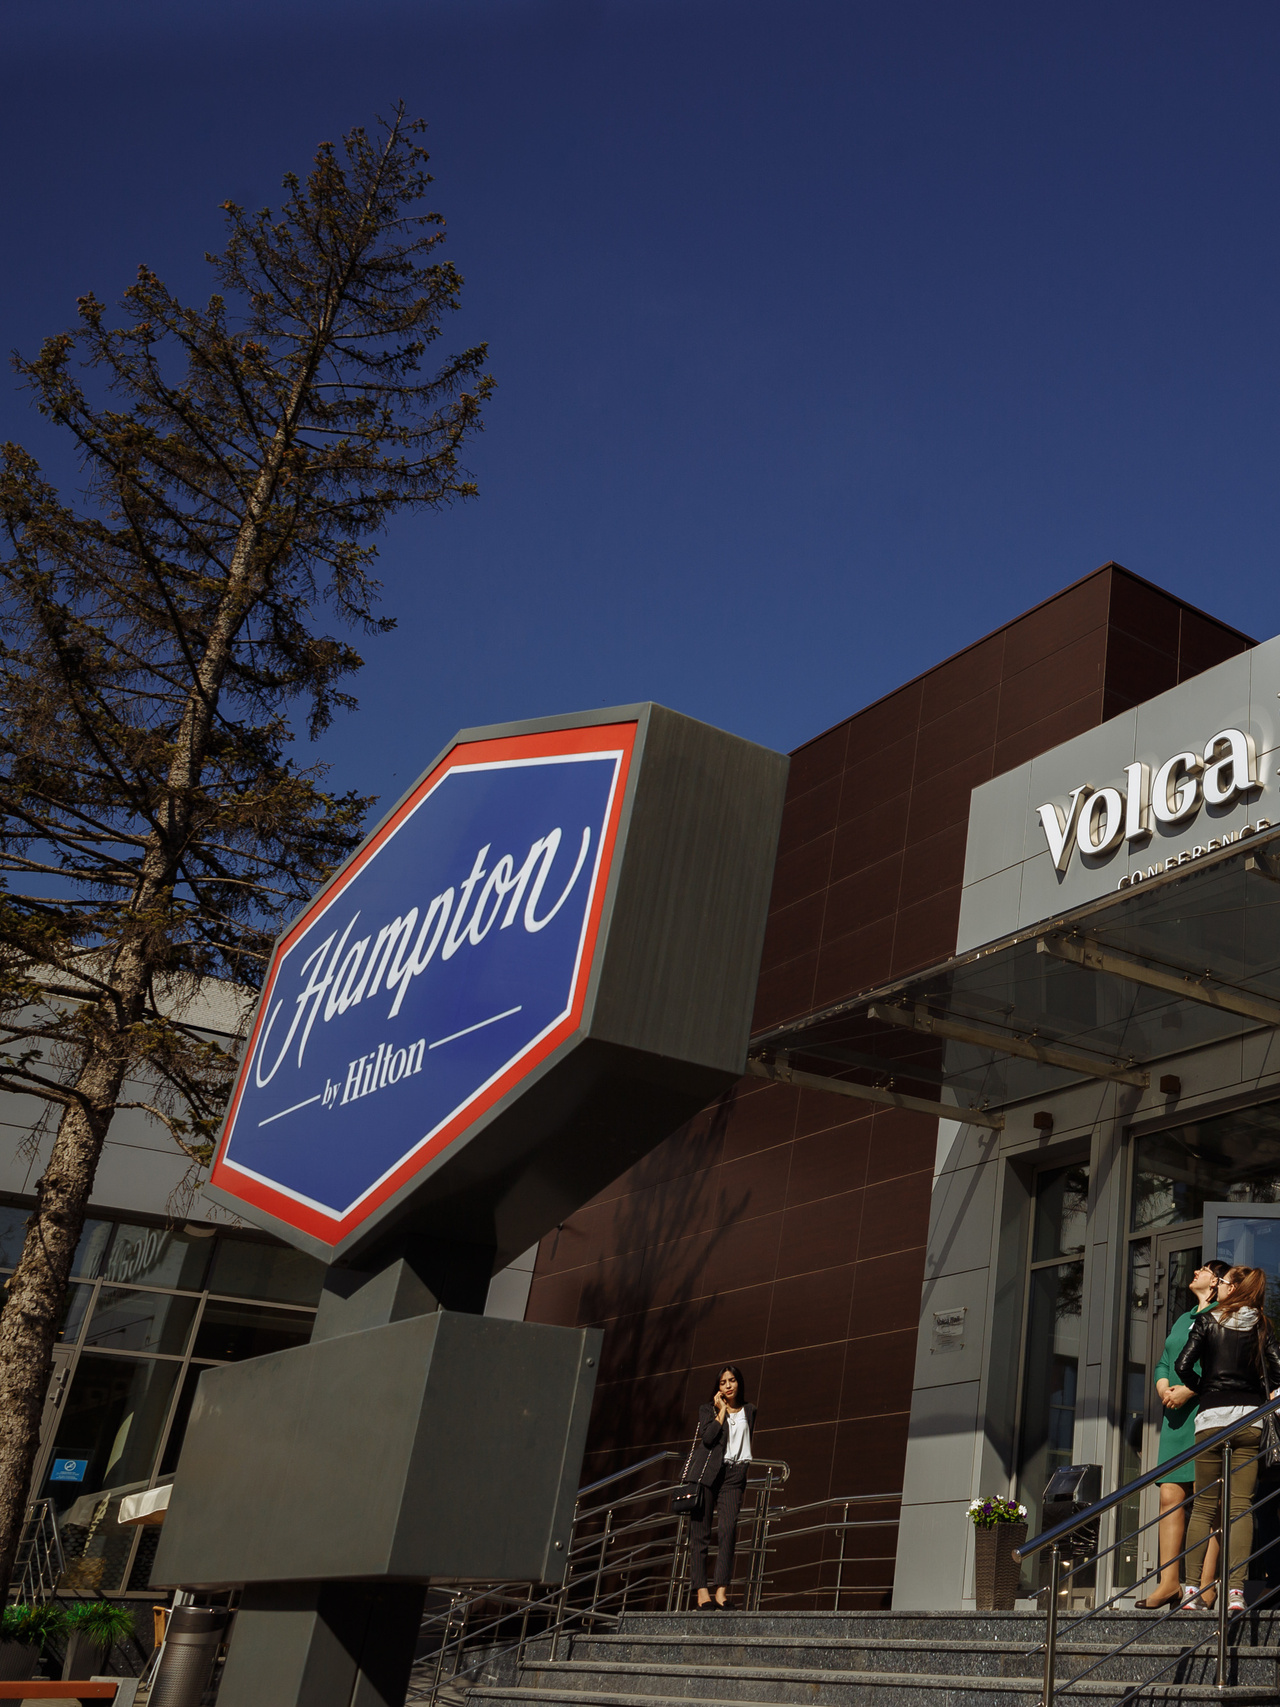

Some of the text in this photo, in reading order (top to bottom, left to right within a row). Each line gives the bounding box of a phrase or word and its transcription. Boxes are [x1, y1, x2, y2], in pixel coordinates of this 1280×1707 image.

[257, 825, 591, 1088] Hampton
[321, 1037, 426, 1109] by Hilton
